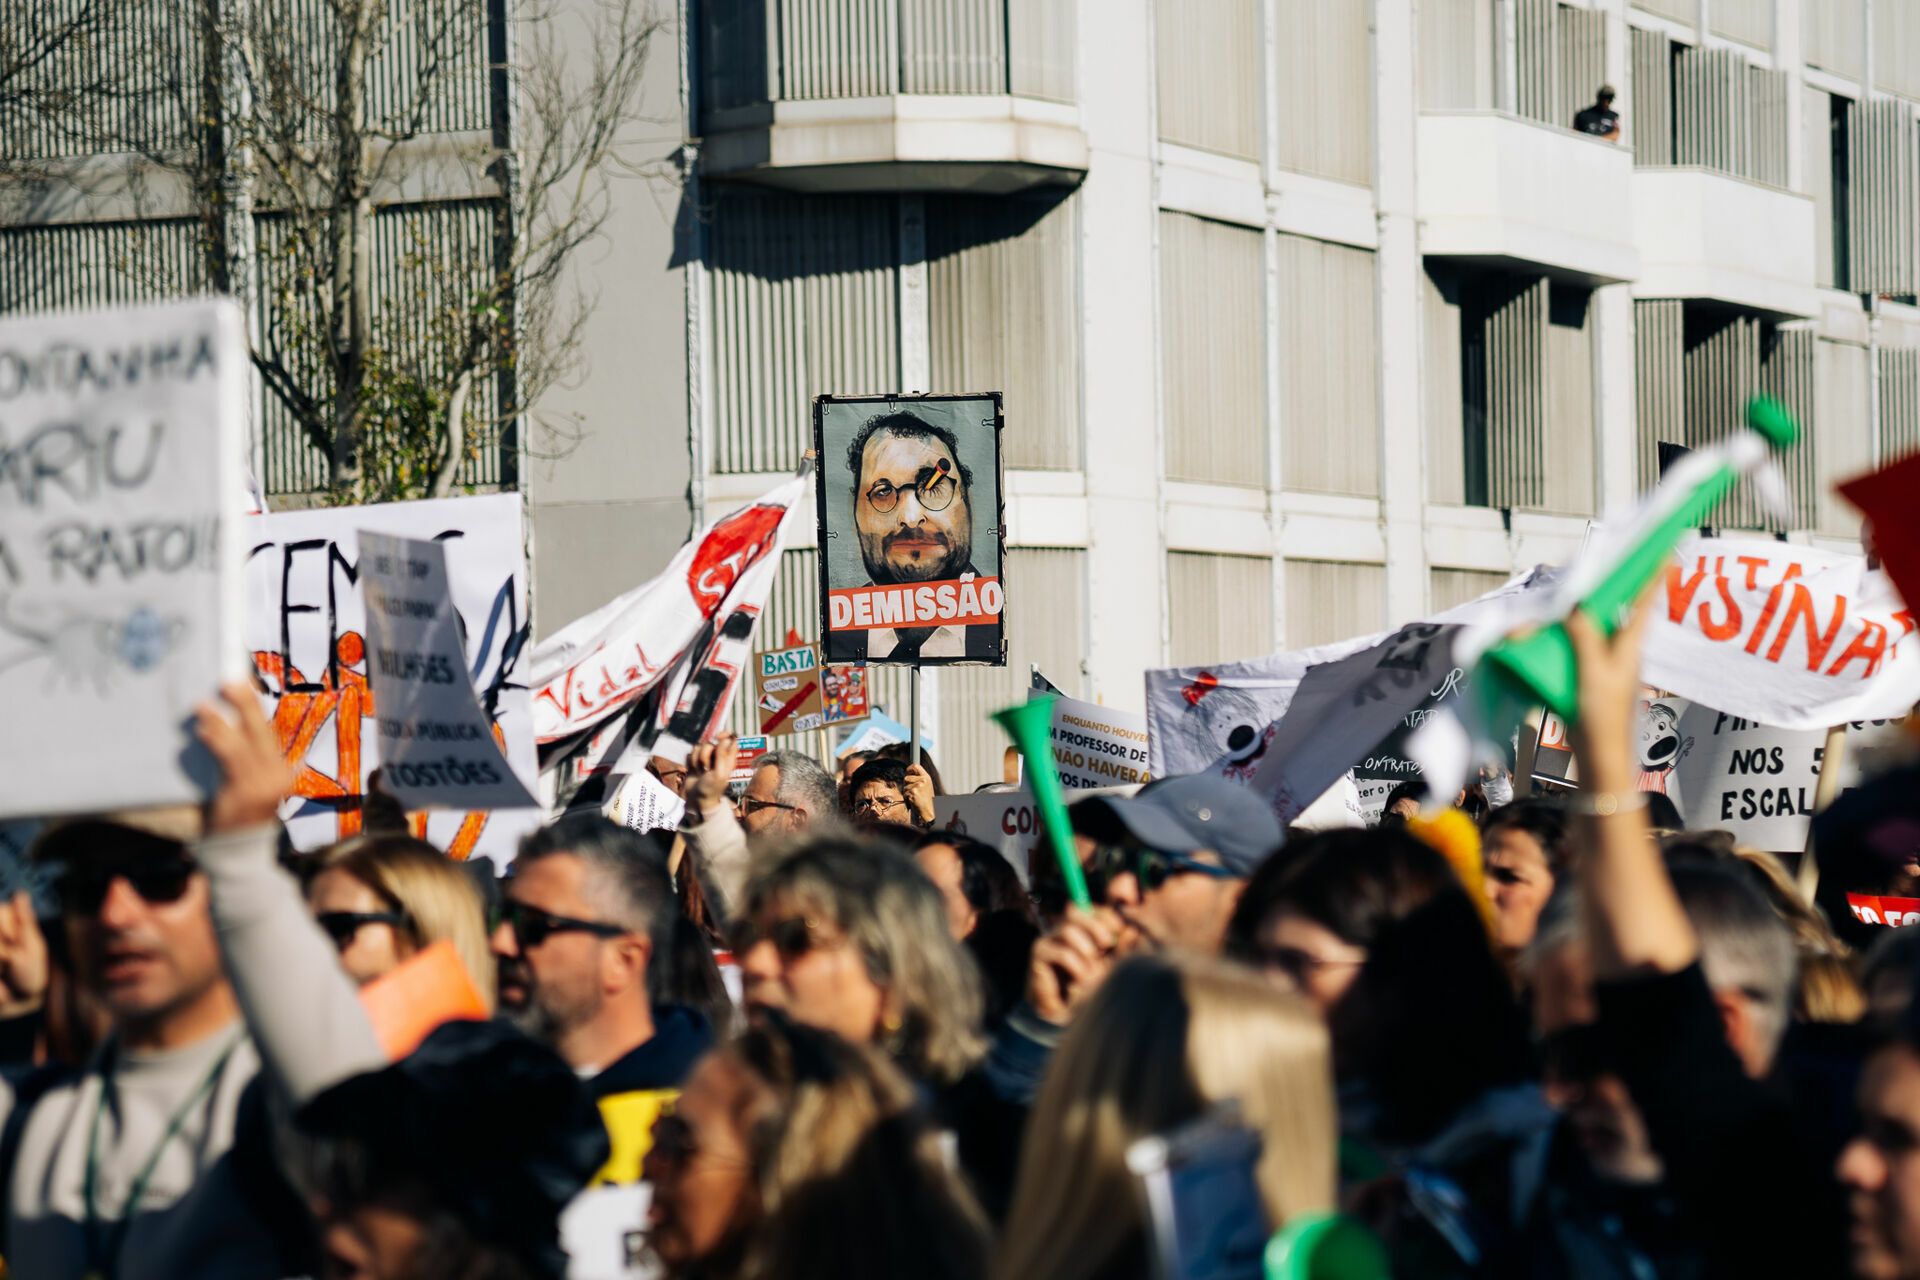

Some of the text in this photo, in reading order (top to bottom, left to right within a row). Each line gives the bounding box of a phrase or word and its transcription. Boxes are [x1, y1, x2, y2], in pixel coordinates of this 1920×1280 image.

[831, 572, 1004, 628] DEMISSÃO
[764, 649, 815, 675] BASTA
[1062, 714, 1111, 734] ENQUANTO
[1051, 746, 1084, 768] NÃO
[1060, 729, 1127, 758] PROFESSOR
[1130, 748, 1147, 763] DE
[1728, 746, 1784, 775] NOS
[385, 755, 502, 788] TOSTÕES
[1365, 755, 1424, 775] ONTRATOS
[1721, 787, 1814, 821] ESCAL
